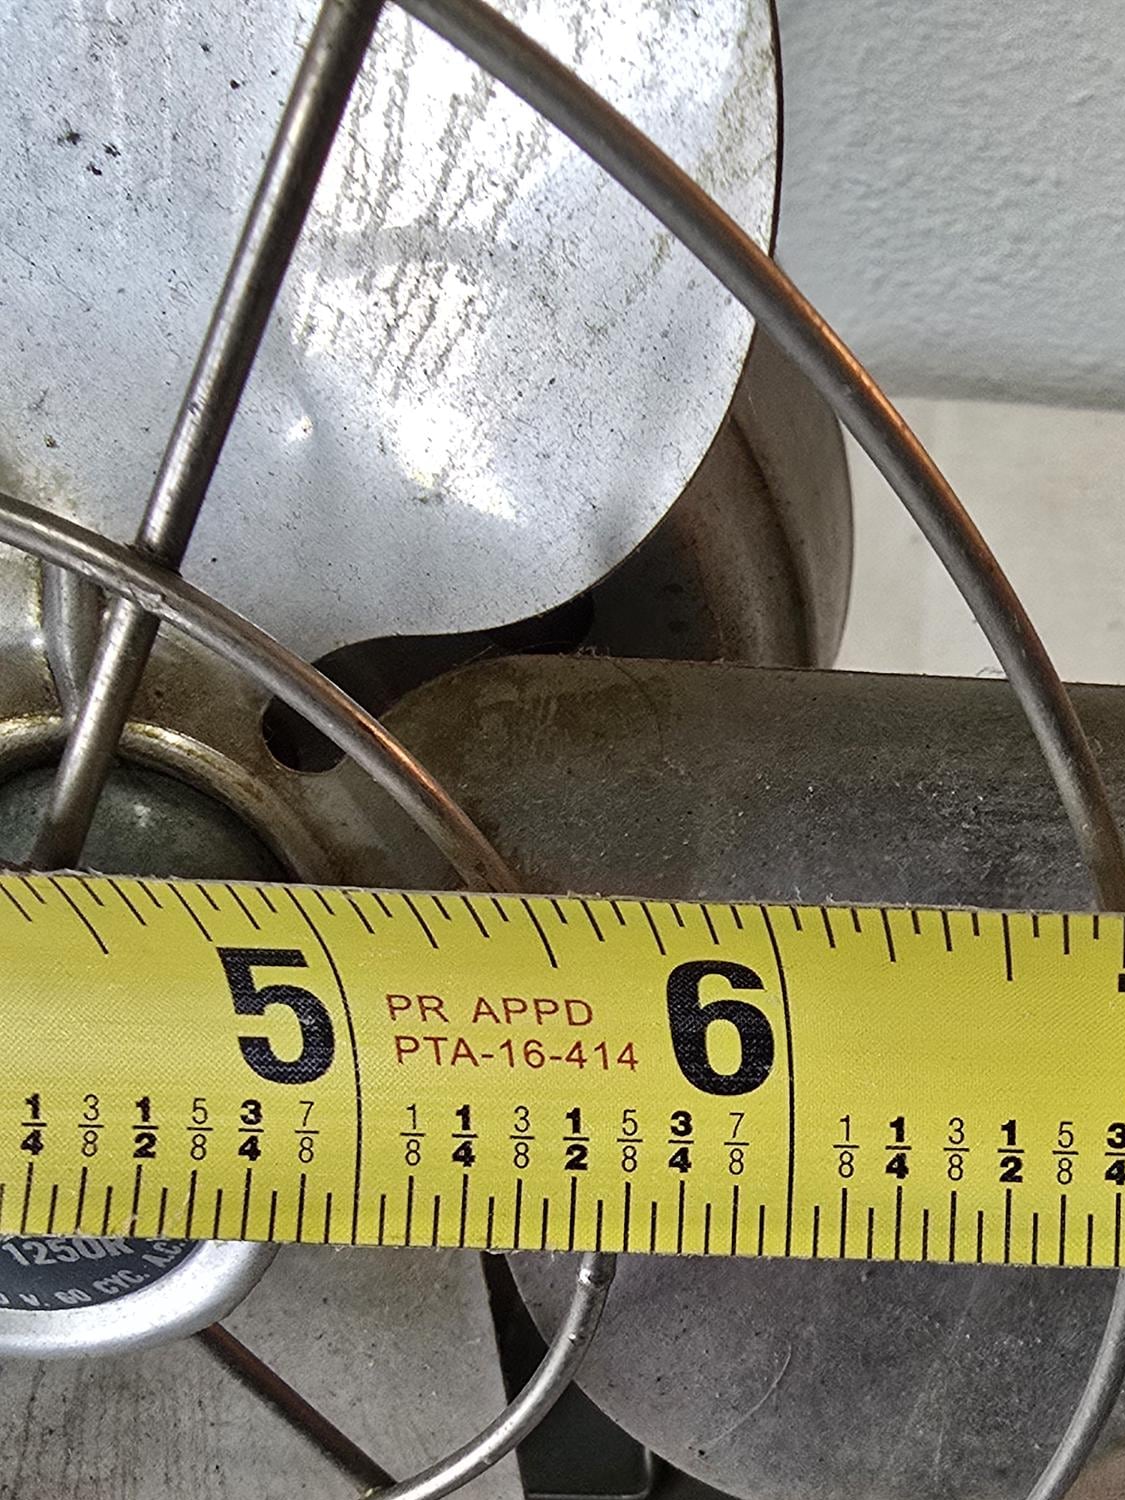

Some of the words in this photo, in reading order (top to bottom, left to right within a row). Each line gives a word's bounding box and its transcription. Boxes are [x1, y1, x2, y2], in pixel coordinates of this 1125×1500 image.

[216, 947, 335, 1085] 5
[387, 994, 449, 1024] PR
[471, 996, 593, 1027] APPD
[667, 960, 774, 1096] 6
[394, 1035, 639, 1071] PTA-16-414
[54, 1287, 93, 1305] 60
[92, 1268, 152, 1296] CYC.
